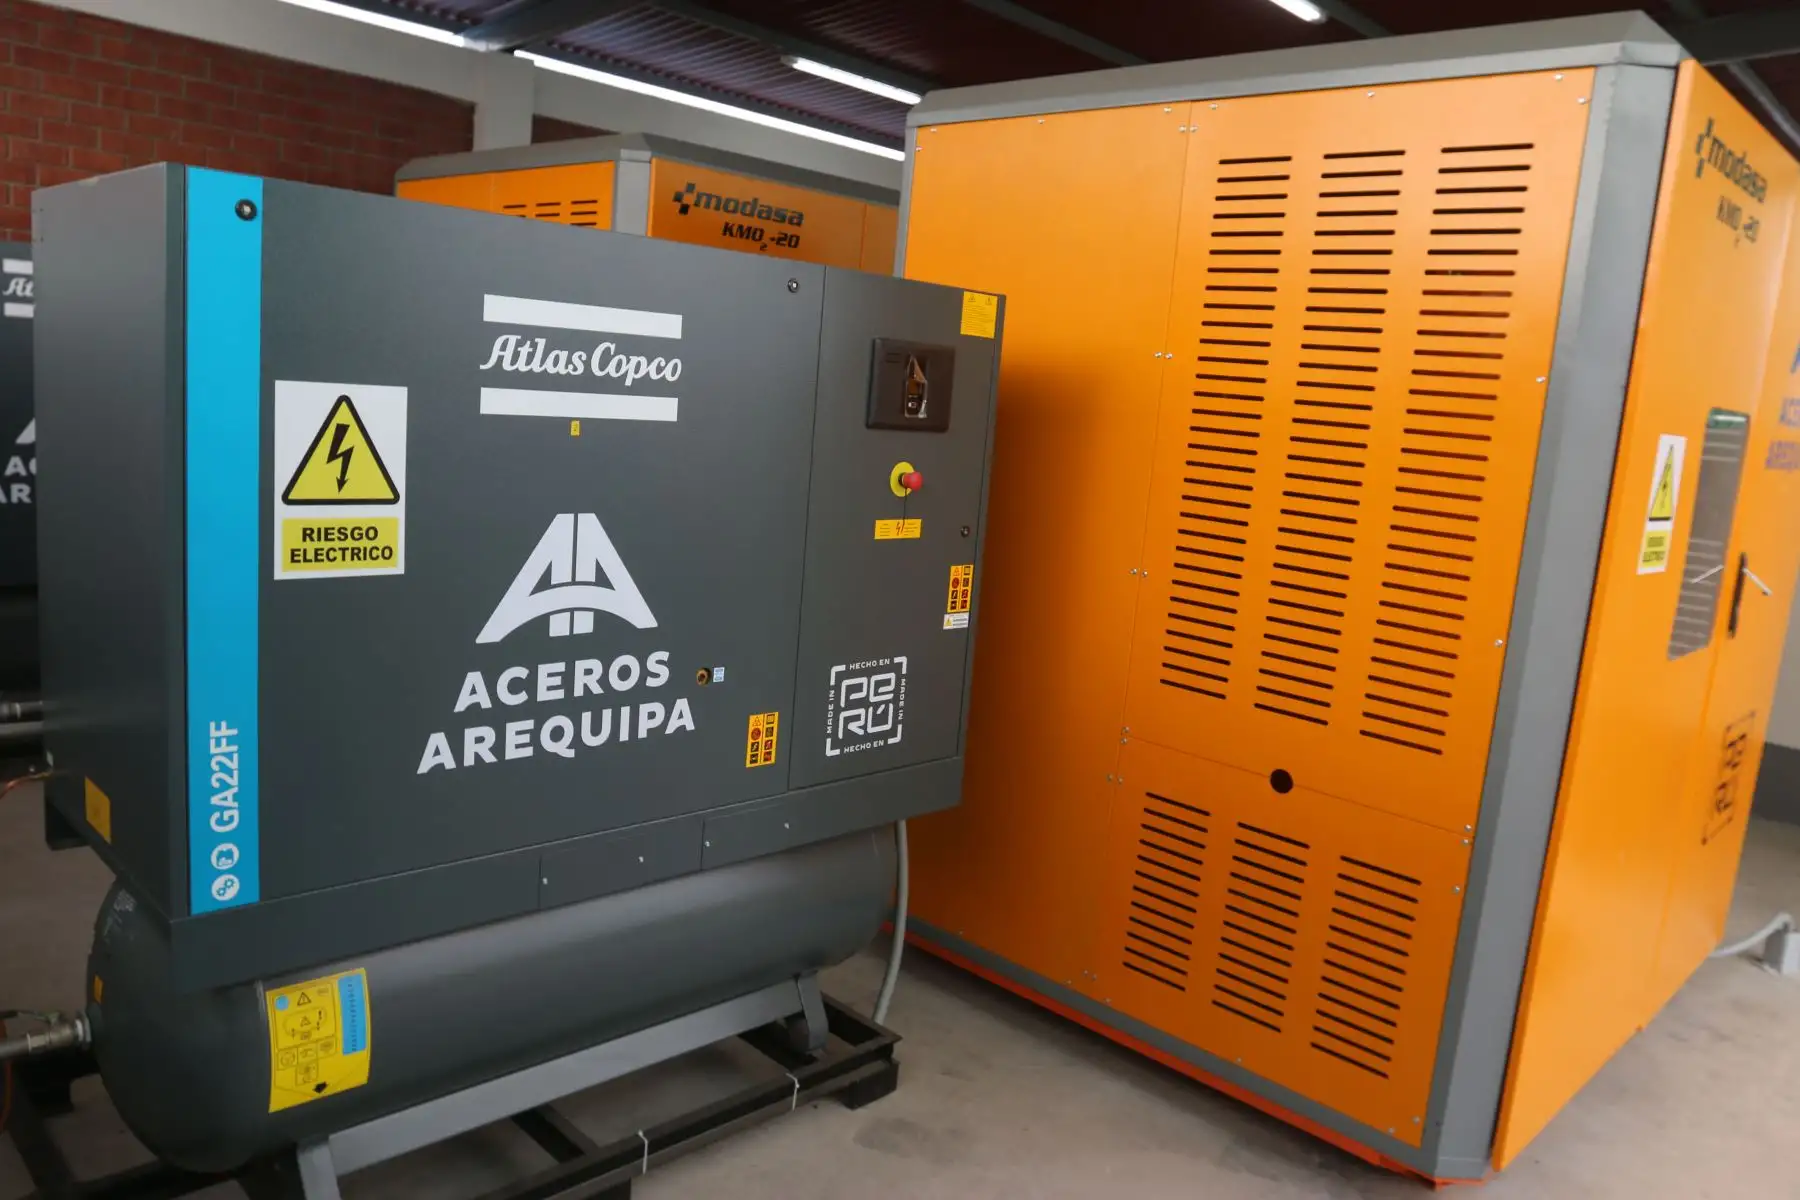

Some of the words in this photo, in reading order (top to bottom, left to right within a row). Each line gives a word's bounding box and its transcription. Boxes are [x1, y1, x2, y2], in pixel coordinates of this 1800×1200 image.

[694, 191, 804, 228] modasa
[480, 334, 587, 375] Atlas
[590, 341, 683, 387] Copco
[302, 526, 379, 543] RIESGO
[290, 545, 393, 564] ELECTRICO
[849, 660, 878, 670] HECHO
[879, 658, 891, 666] EN
[453, 651, 670, 713] ACEROS
[829, 690, 835, 701] IN
[826, 703, 834, 734] MADE
[898, 710, 904, 720] IN
[416, 697, 696, 775] AREQUIPA
[843, 742, 872, 753] HECHO
[873, 740, 884, 748] EN
[209, 720, 239, 833] GA22FF
